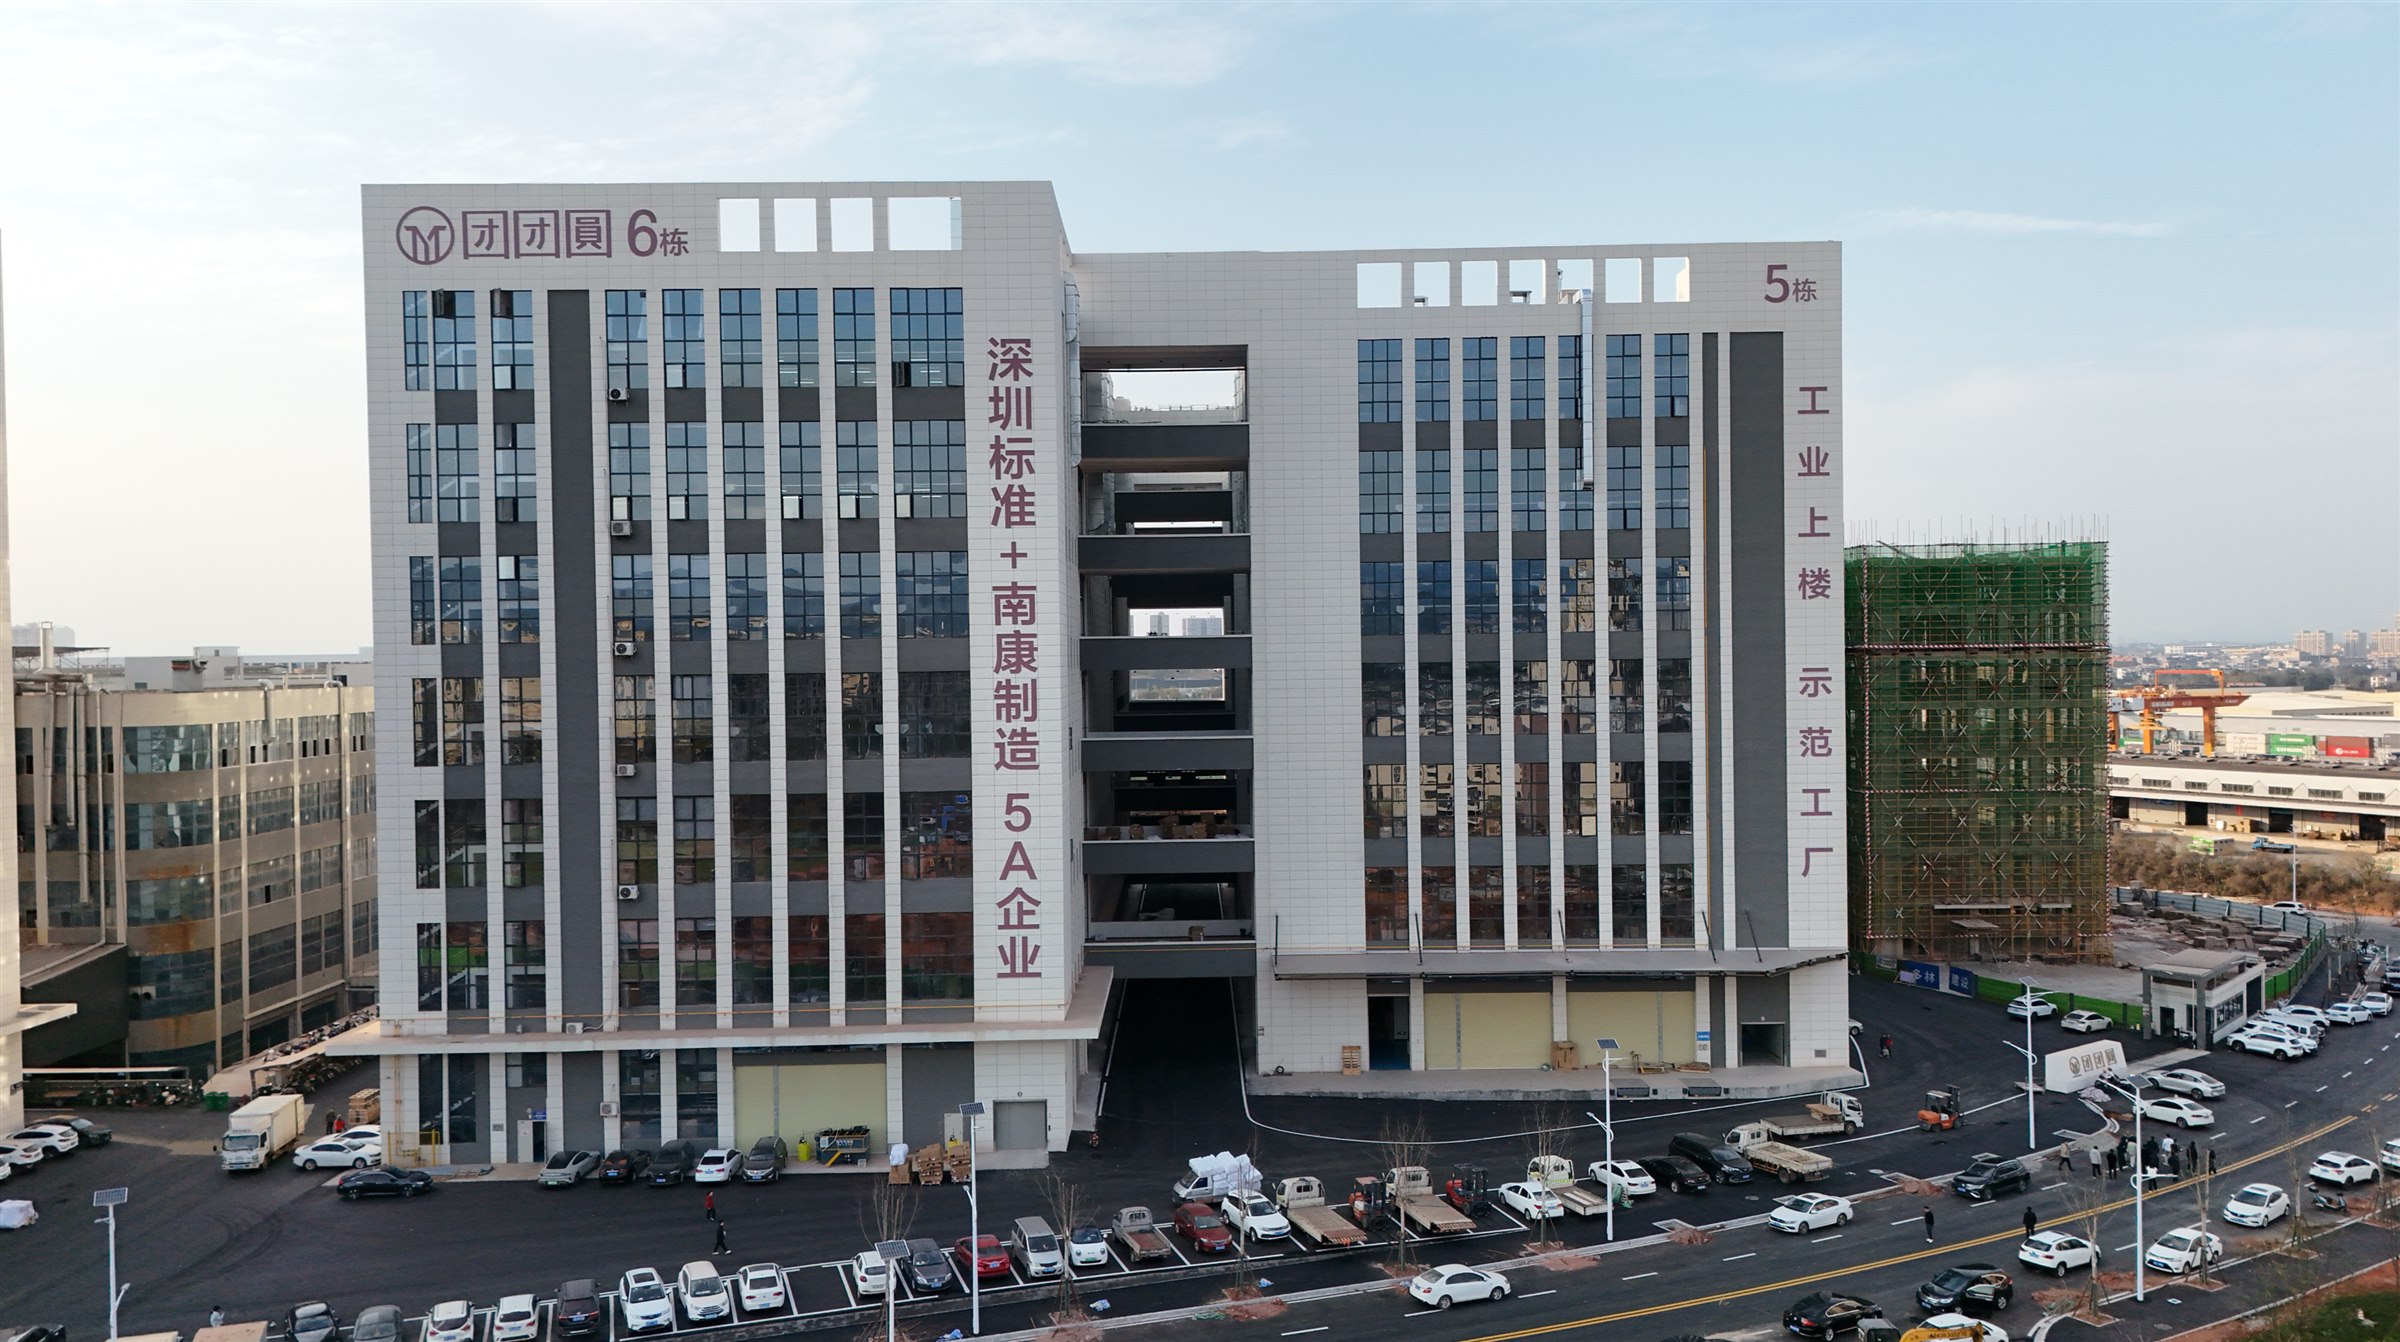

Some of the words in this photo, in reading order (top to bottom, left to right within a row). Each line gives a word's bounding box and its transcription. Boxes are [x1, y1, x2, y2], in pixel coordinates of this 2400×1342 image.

[1764, 264, 1817, 304] 5栋
[1798, 387, 1831, 600] 工业上楼
[1799, 667, 1833, 877] 示范工厂
[996, 792, 1042, 980] 5A企业
